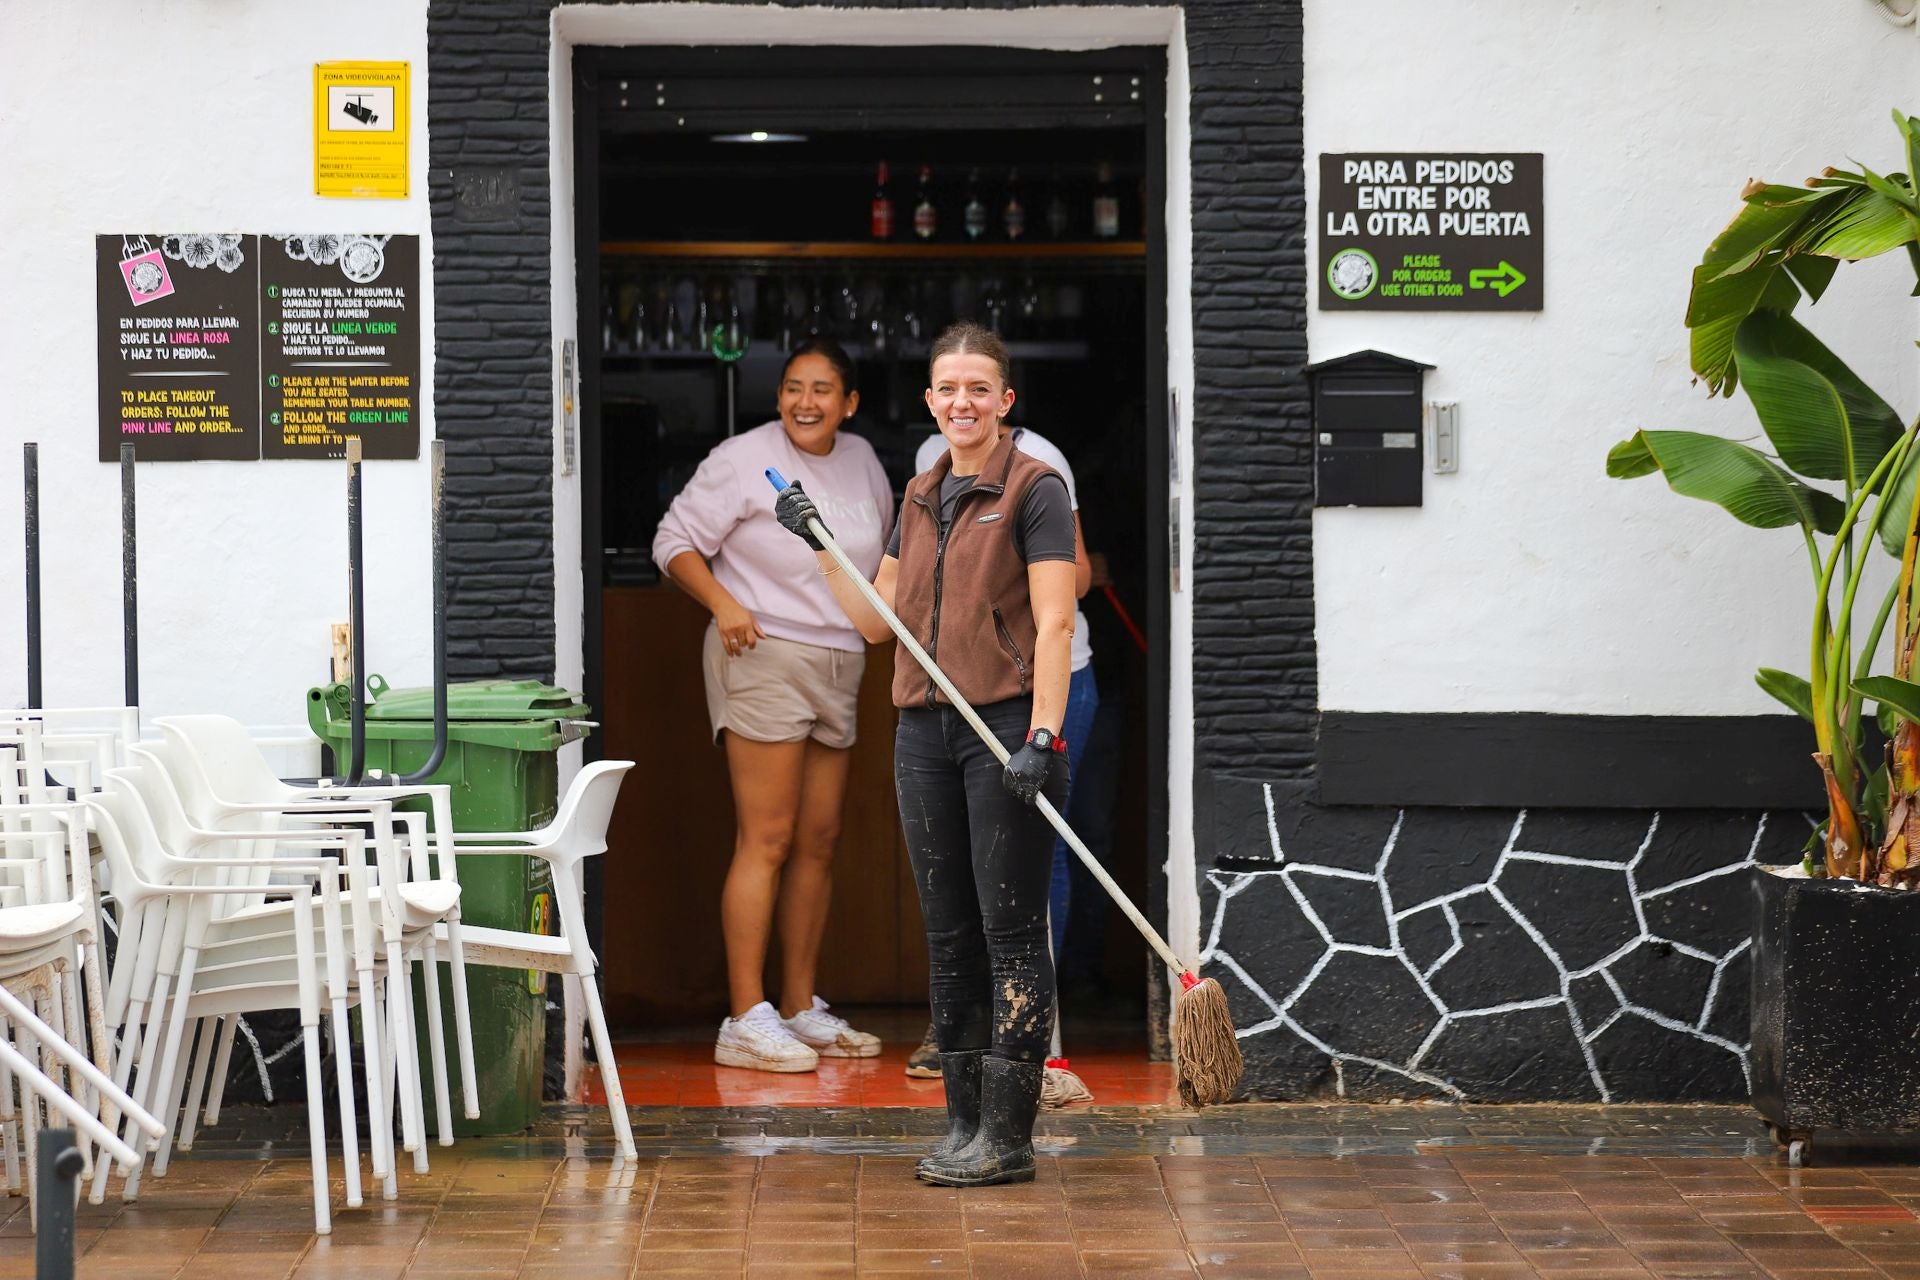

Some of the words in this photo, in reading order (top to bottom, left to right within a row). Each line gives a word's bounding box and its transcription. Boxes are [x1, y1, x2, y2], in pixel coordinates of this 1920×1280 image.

[1344, 160, 1407, 184] PARA
[1416, 160, 1514, 184] PEDIDOS
[1358, 186, 1436, 209] ENTRE
[1446, 186, 1490, 209] POR
[1327, 212, 1359, 236] LA
[1367, 212, 1431, 236] OTRA
[1439, 212, 1531, 236] PUERTA
[1404, 255, 1440, 267] PLEASE
[1414, 269, 1452, 282] ORDERS
[282, 288, 306, 297] BUSCA
[308, 288, 318, 297] TU
[347, 288, 352, 297] Y
[355, 288, 393, 297] PREGUNTA
[396, 288, 405, 297] AL
[1381, 284, 1401, 296] USE
[1403, 284, 1435, 296] OTHER
[1437, 284, 1463, 296] DOOR
[282, 299, 322, 308] CAMARERO
[325, 299, 331, 308] SI
[334, 299, 362, 308] PUEDES
[283, 309, 321, 318] RECUERDA
[323, 310, 334, 318] SU
[337, 309, 369, 318] NUMERO
[120, 318, 132, 328] EN
[136, 318, 173, 329] PEDIDOS
[176, 318, 199, 329] PARA
[202, 318, 239, 330] LLEVAR:
[283, 322, 312, 334] SIGUE
[315, 322, 328, 334] LA
[332, 322, 362, 334] LINEA
[365, 322, 397, 334] VERDE
[121, 333, 149, 344] SIGUE
[153, 333, 166, 344] LA
[170, 332, 200, 344] LINEA
[204, 333, 229, 343] ROSA
[283, 336, 288, 345] Y
[291, 336, 306, 345] HAZ
[309, 336, 319, 344] TU
[121, 348, 129, 360] Y
[132, 348, 152, 359] HAZ
[156, 349, 169, 359] TU
[173, 348, 215, 360] PEDIDO...
[283, 346, 321, 355] NOSOTROS
[324, 346, 334, 355] TE
[336, 346, 345, 355] LO
[348, 346, 385, 355] LLEVAMOS
[283, 377, 312, 386] PLEASE
[314, 377, 330, 386] ASK
[332, 377, 347, 386] THE
[349, 377, 378, 386] WAITER
[381, 377, 409, 386] BEFORE
[121, 391, 134, 402] TO
[138, 390, 167, 402] PLACE
[171, 390, 215, 402] TAKEOUT
[283, 388, 298, 396] YOU
[301, 388, 316, 397] ARE
[283, 398, 325, 407] REMEMBER
[328, 398, 348, 407] YOUR
[351, 398, 374, 407] TABLE
[122, 406, 163, 418] ORDERS:
[166, 406, 206, 418] FOLLOW
[209, 406, 229, 418] THE
[284, 411, 323, 423] FOLLOW
[327, 412, 346, 423] THE
[349, 411, 382, 423] GREEN
[386, 411, 408, 423] LINE
[122, 422, 145, 433] PINK
[149, 422, 172, 433] LINE
[175, 422, 196, 432] AND
[284, 425, 300, 433] AND
[284, 435, 295, 444] WE
[298, 435, 320, 444] BRING
[323, 435, 330, 444] IT
[333, 435, 342, 444] TO
